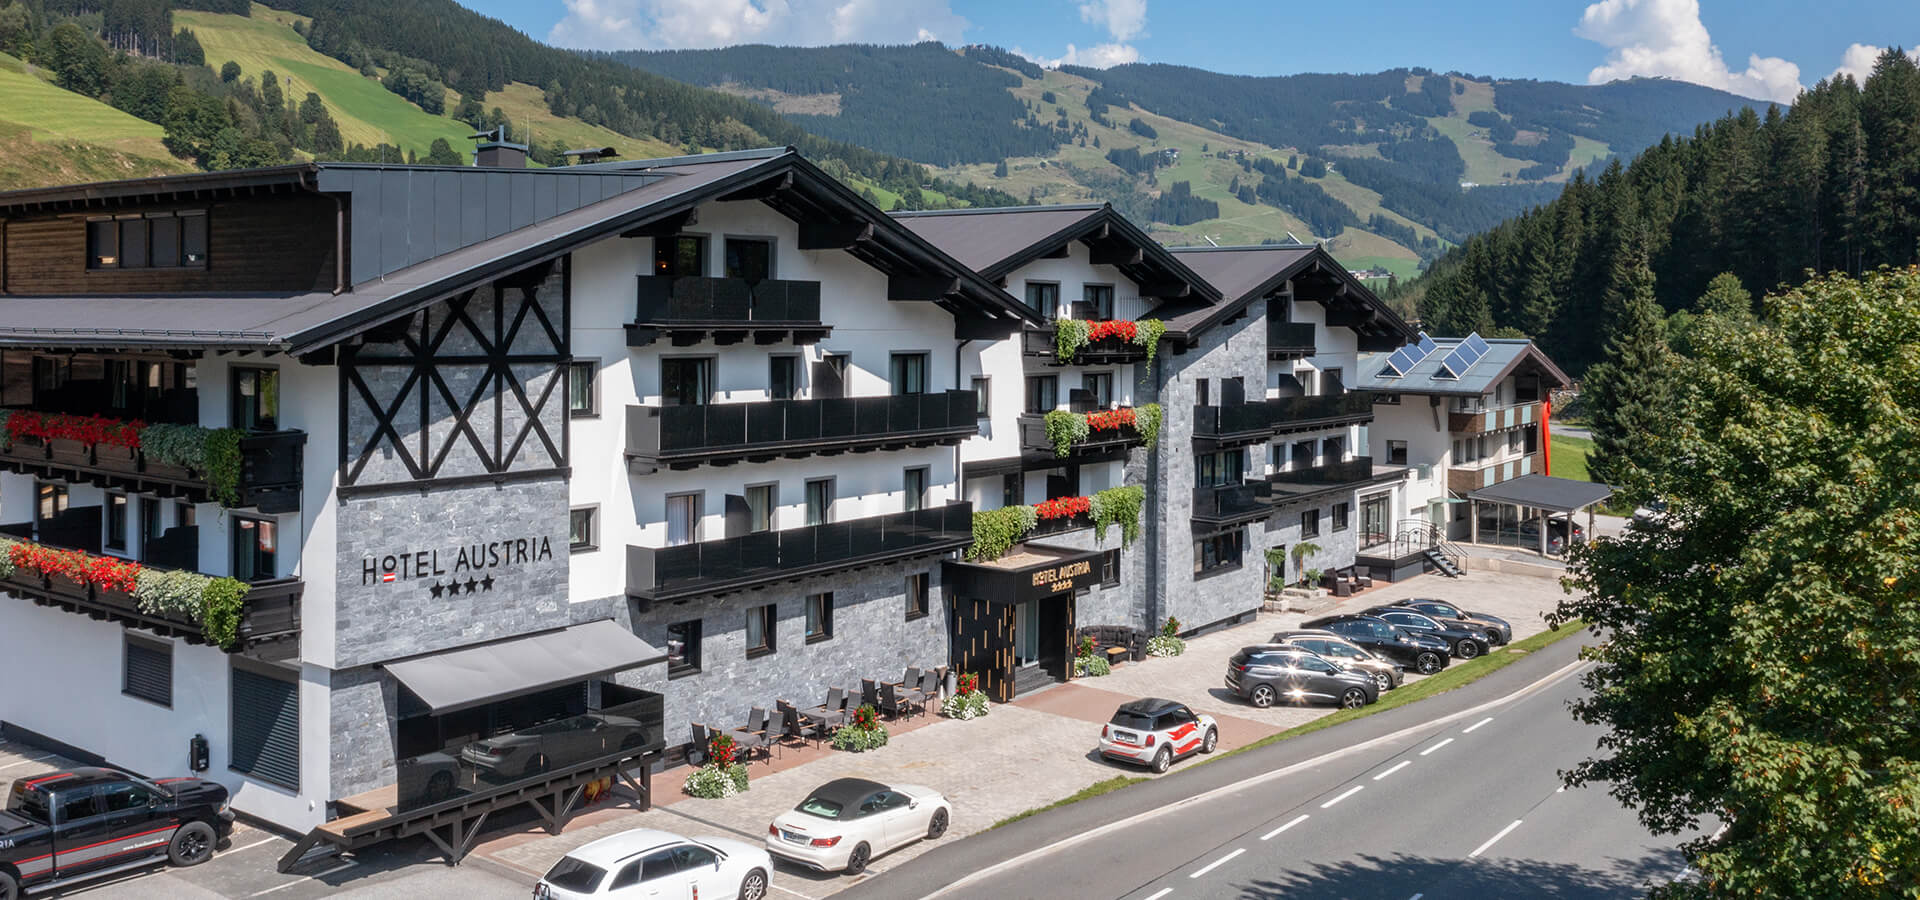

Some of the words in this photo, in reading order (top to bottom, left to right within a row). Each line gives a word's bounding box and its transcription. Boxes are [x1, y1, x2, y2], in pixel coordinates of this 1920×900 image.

[362, 549, 446, 586] HOTEL
[455, 535, 553, 573] AUSTRIA
[1032, 569, 1058, 586] HOTEL
[1059, 561, 1091, 579] AUSTRIA
